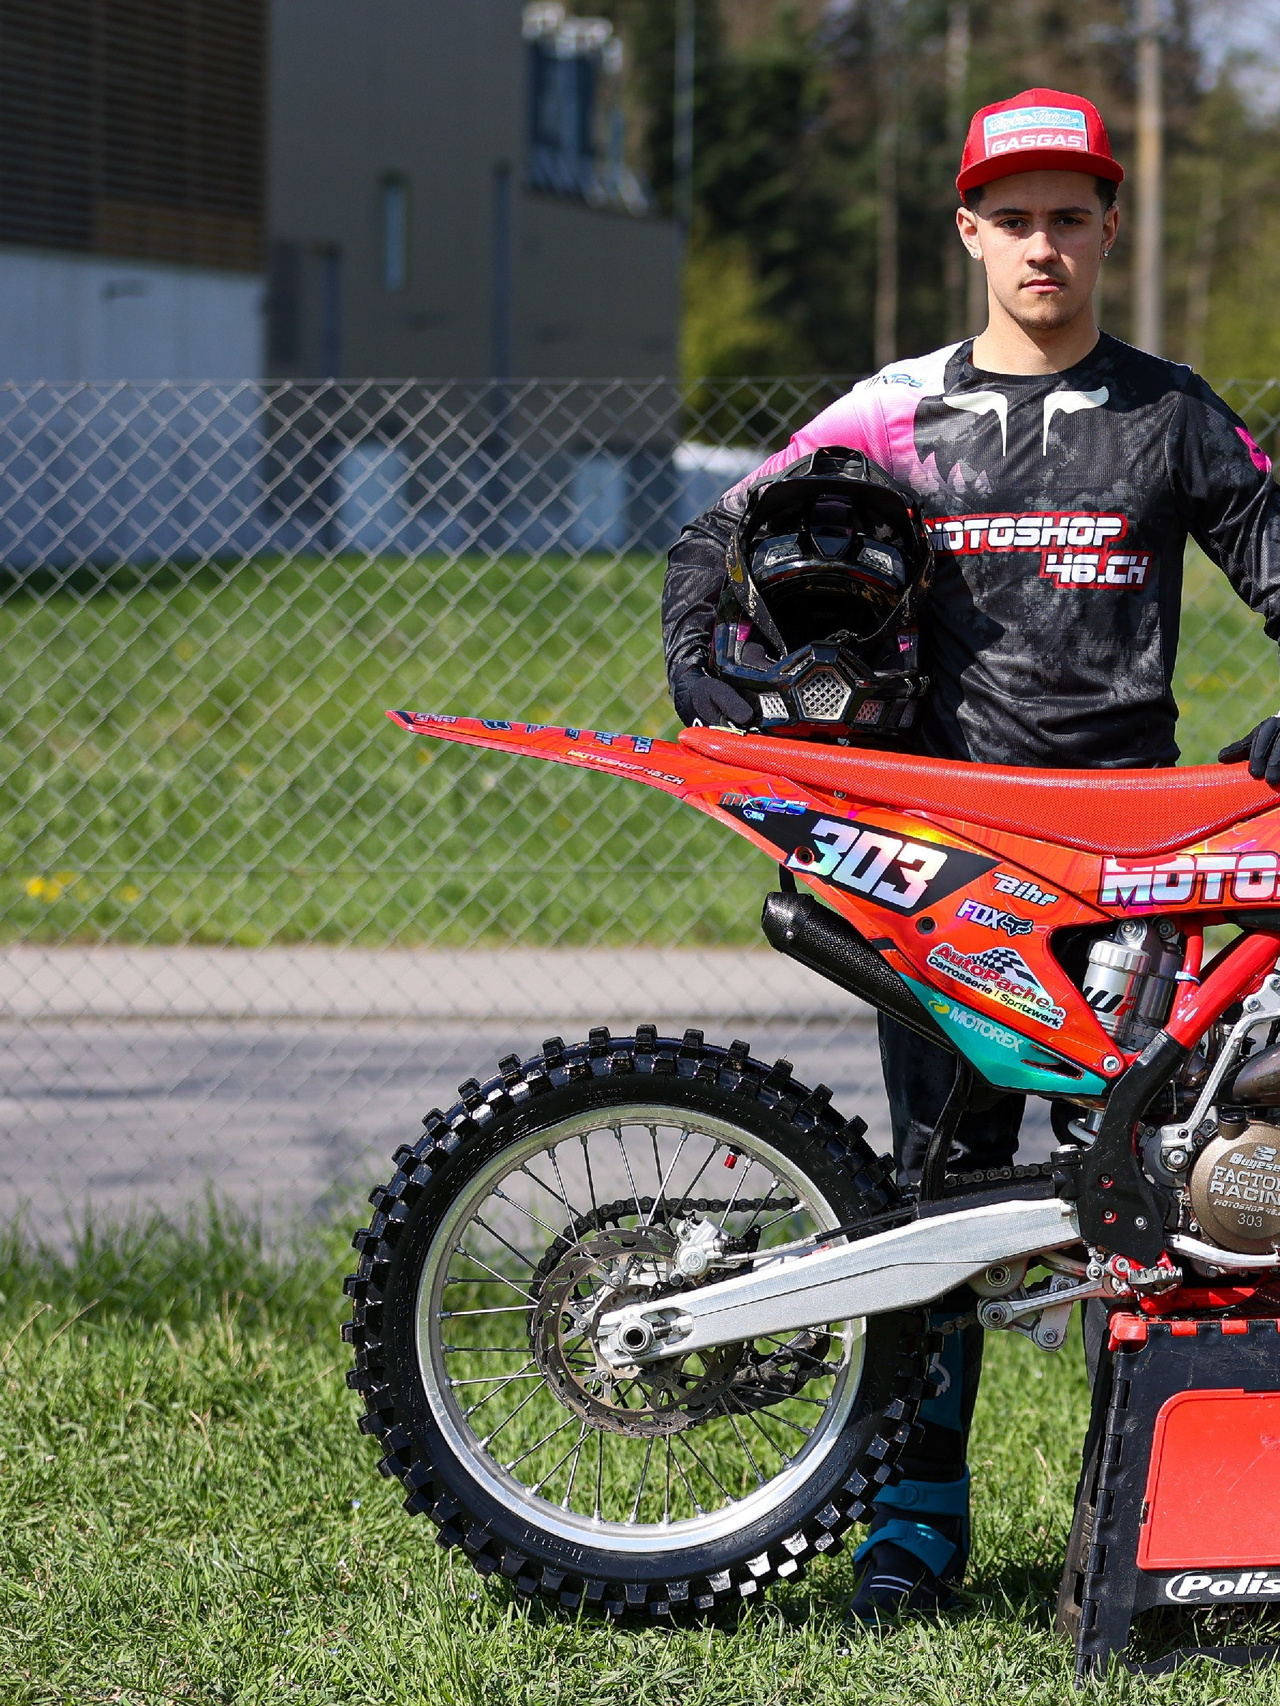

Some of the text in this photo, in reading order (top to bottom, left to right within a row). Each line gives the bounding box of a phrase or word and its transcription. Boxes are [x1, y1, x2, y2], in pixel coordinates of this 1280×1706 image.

[990, 133, 1083, 155] GASGAS
[1045, 553, 1150, 584] 46.CH
[786, 818, 948, 909] 303
[993, 872, 1058, 906] Bihr
[956, 898, 1005, 931] FOX
[928, 955, 1063, 1029] Carrosserie Spritzwerk
[949, 1006, 1024, 1053] MOTOREX
[1213, 1198, 1265, 1213] MOTOSHOP
[1237, 1212, 1263, 1228] 303
